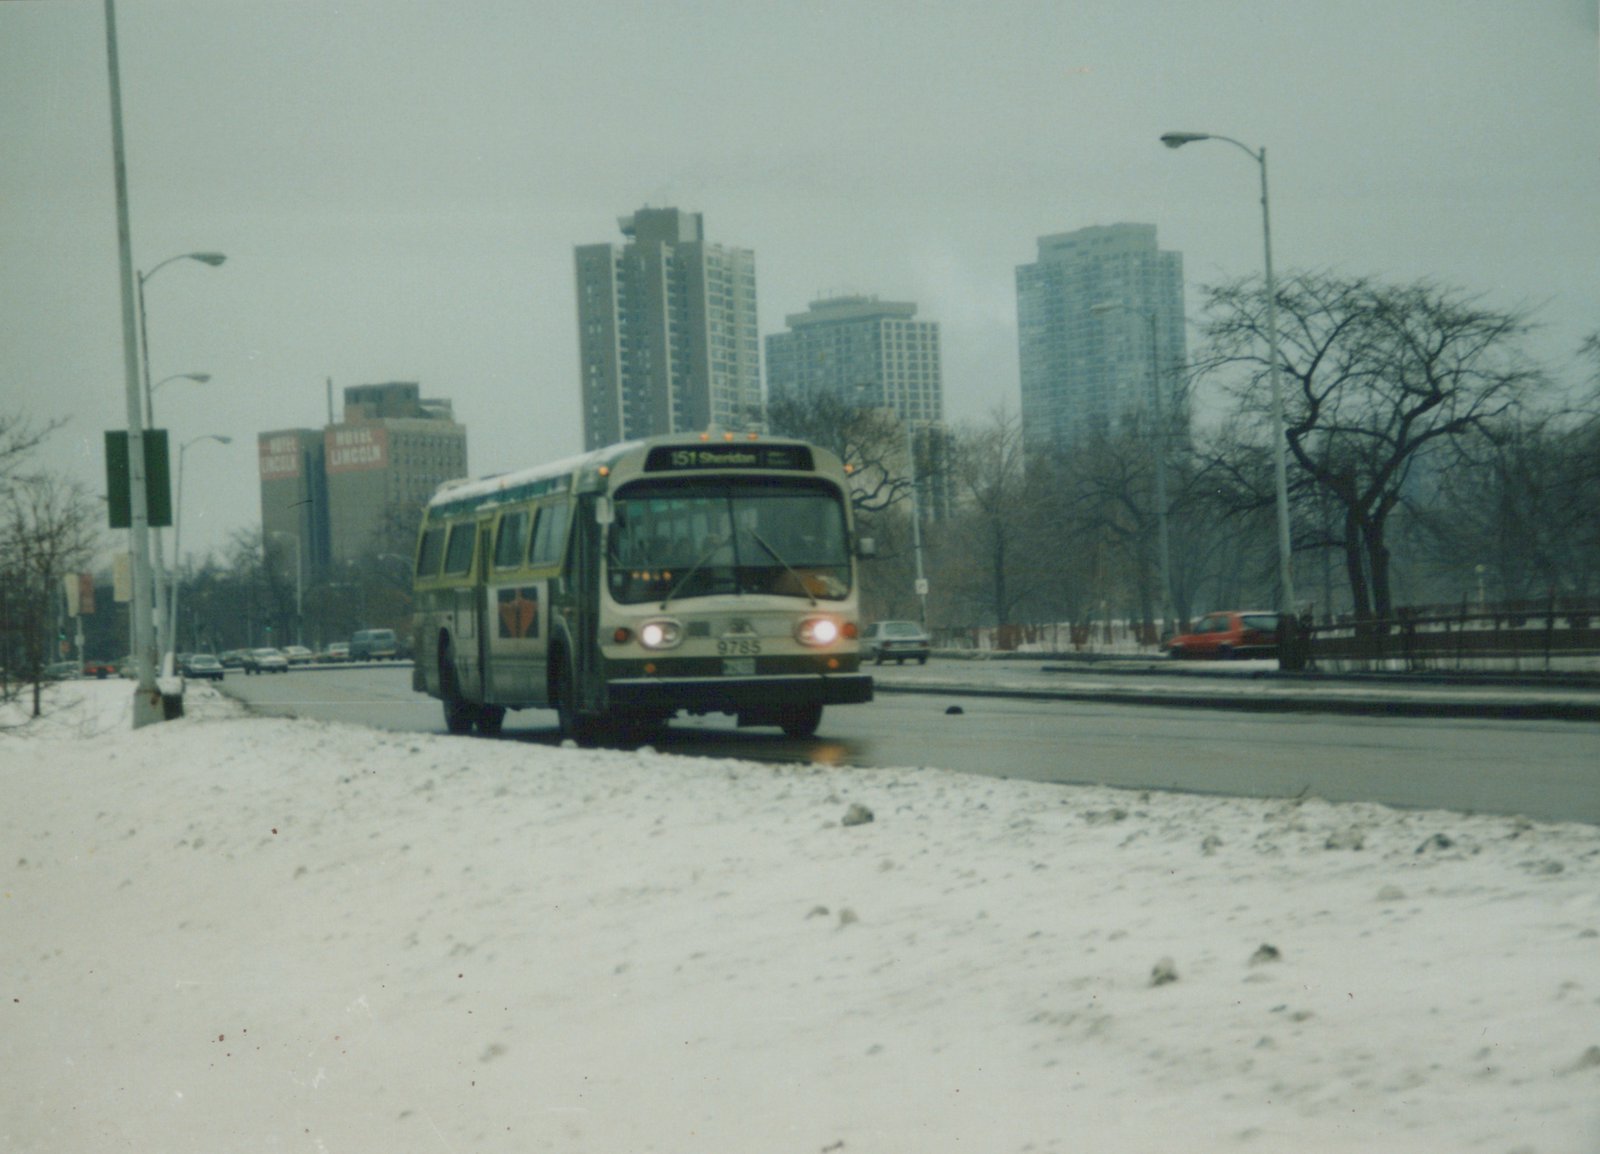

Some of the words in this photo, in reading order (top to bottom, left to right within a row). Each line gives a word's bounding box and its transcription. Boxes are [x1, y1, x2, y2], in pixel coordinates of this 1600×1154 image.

[672, 451, 696, 466] 151
[699, 452, 756, 464] Sheridan
[717, 639, 762, 655] 9785
